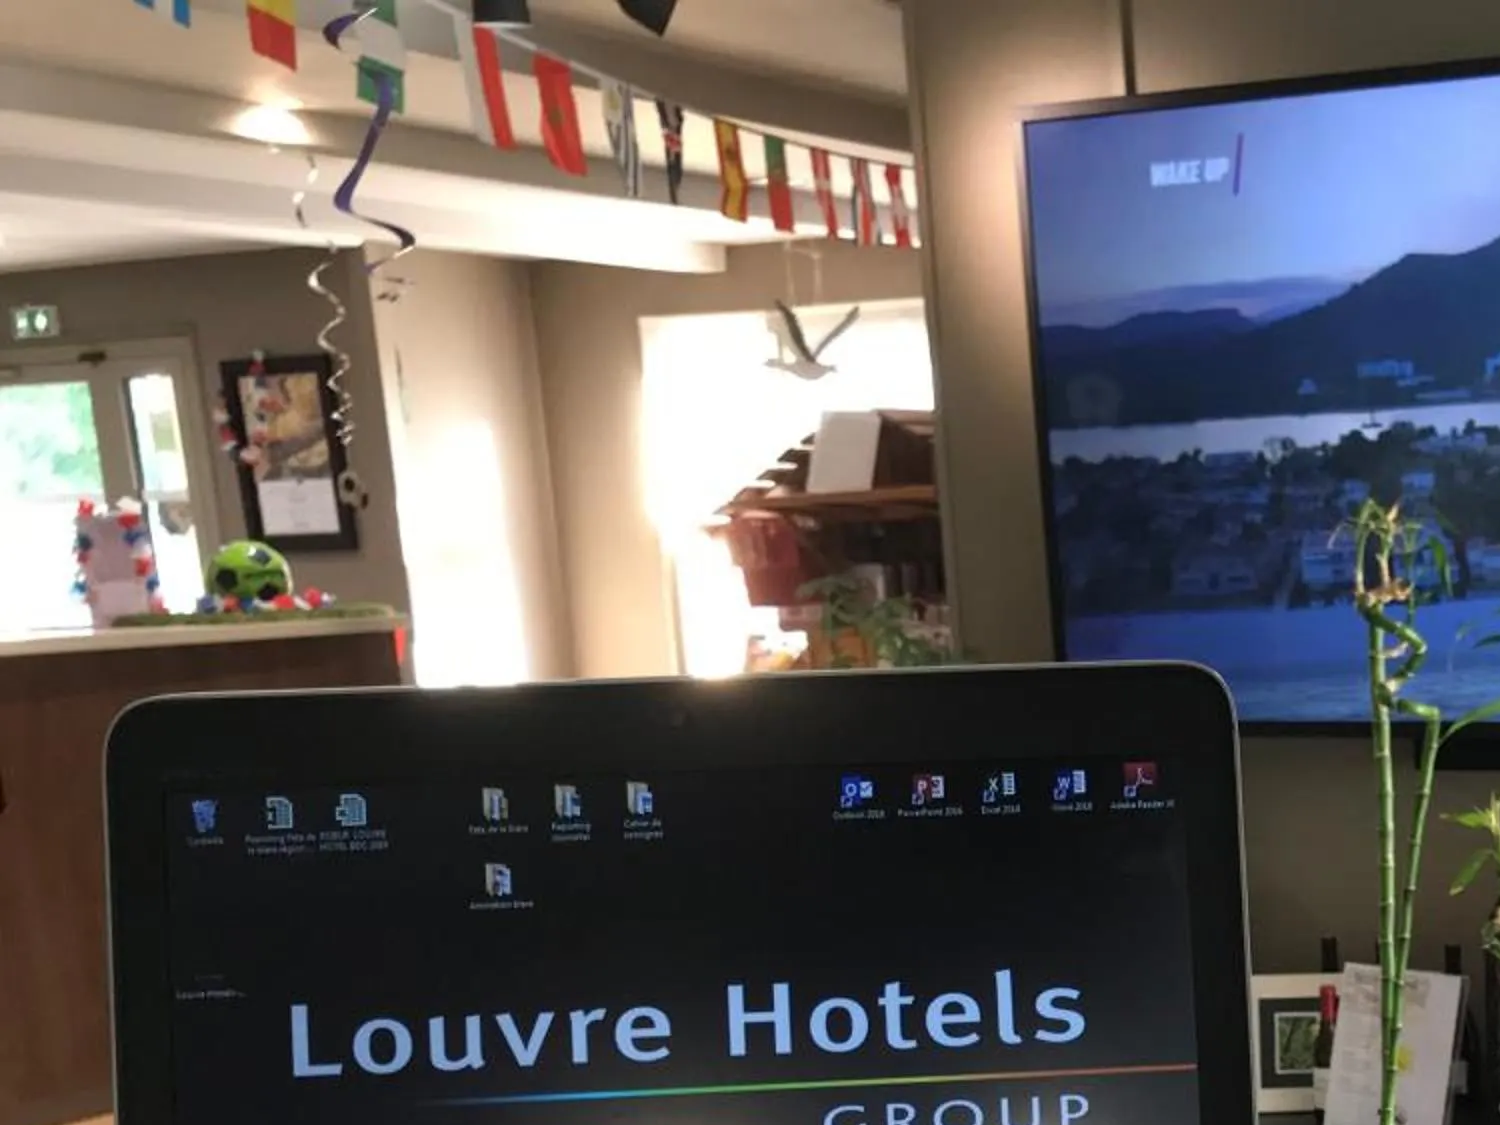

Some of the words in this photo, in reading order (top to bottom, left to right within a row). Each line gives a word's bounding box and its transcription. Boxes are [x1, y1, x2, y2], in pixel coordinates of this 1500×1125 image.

[1150, 160, 1201, 187] WAKE
[1204, 157, 1230, 183] UP
[292, 1005, 671, 1077] Louvre
[728, 969, 1085, 1057] Hotels
